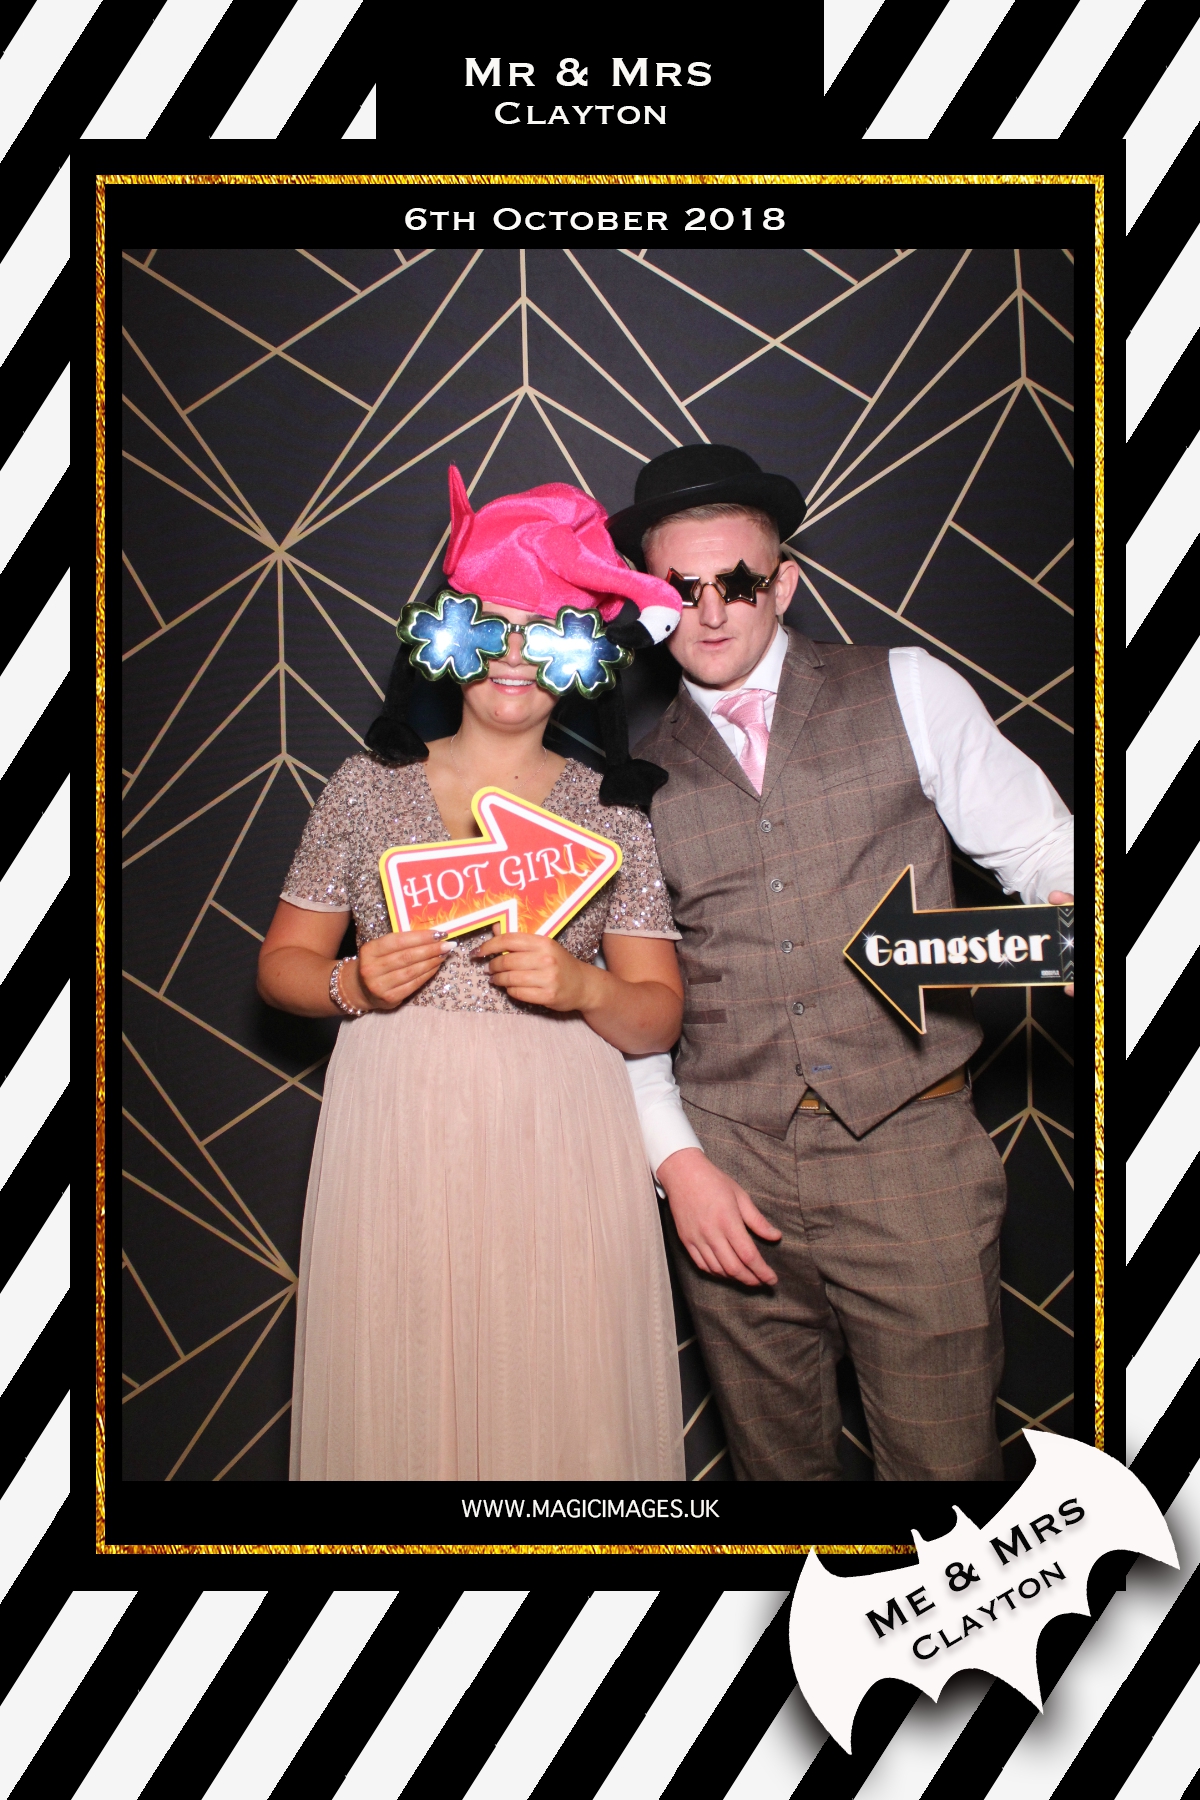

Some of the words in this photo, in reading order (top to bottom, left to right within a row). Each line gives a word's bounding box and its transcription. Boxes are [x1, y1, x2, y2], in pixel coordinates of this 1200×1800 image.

[403, 861, 490, 908] HOT
[498, 843, 588, 891] GIRL
[865, 928, 1051, 967] Gangster
